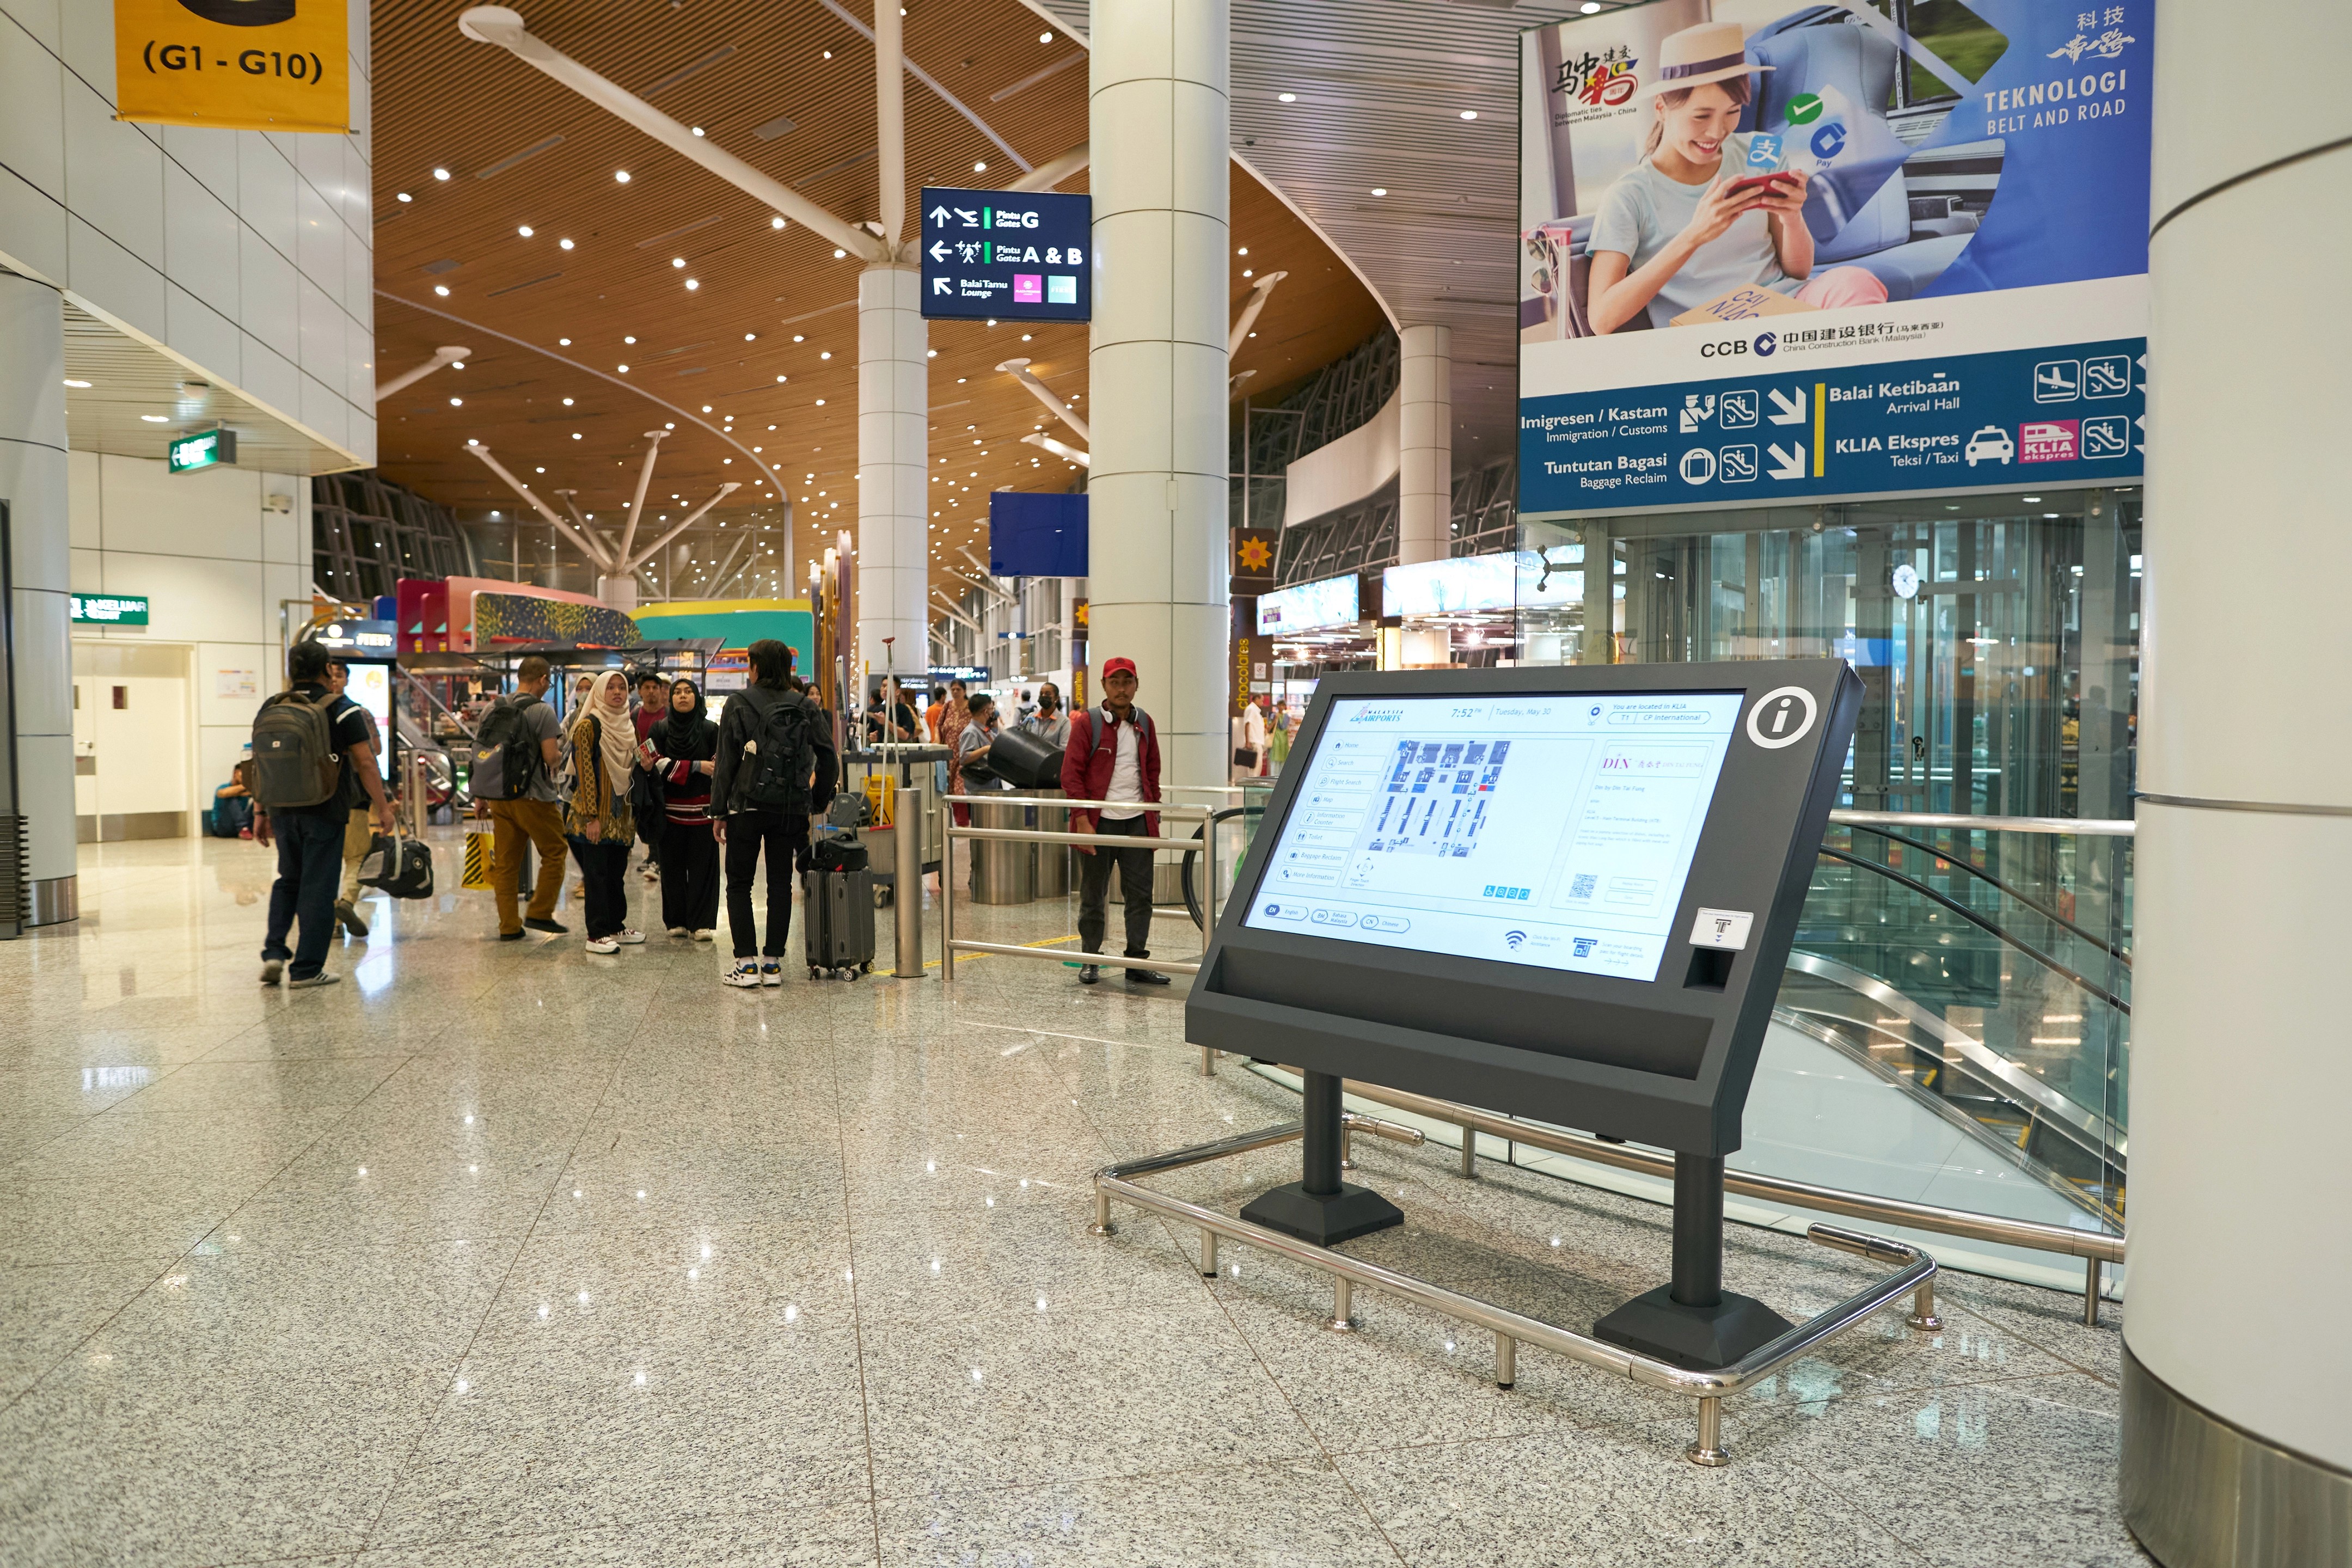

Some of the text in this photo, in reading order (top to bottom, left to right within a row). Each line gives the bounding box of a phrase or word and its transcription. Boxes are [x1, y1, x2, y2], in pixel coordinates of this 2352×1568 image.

[2078, 5, 2125, 30] 科技
[143, 40, 201, 74] (G1
[238, 48, 323, 85] G10)
[1985, 69, 2126, 113] TEKNOLOGI
[1555, 109, 1588, 120] Diplomatic
[1555, 118, 1582, 127] between
[1584, 113, 1612, 121] Malaysia
[1988, 100, 2126, 136] BELT AND ROAD
[1816, 158, 1832, 168] Pay
[996, 210, 1039, 228] Pintu G
[996, 219, 1021, 228] Gates
[996, 246, 1082, 265] Pintu A & B
[996, 254, 1021, 262] Gates
[960, 279, 1007, 289] Balai Tamu
[961, 289, 992, 298] Lounge
[1701, 340, 1748, 358] CCB
[1783, 331, 1926, 353] China Construction Bank (Malaysia)
[1830, 379, 1960, 402] Balai Ketibaan
[1886, 397, 1960, 414] Arrival Hall
[1521, 412, 1594, 430] Imigresen
[1608, 406, 1668, 422] Kastam
[1546, 427, 1608, 443] Immigration
[1619, 423, 1668, 437] Customs
[1836, 433, 1959, 454] KLIA Ekspres
[2025, 442, 2072, 454] KLIA
[1545, 453, 1667, 474] Tuntutan Bagasi
[1890, 455, 1921, 467] Teksi
[1933, 451, 1958, 464] Taxi
[2024, 451, 2074, 460] ekspres
[1581, 473, 1667, 489] Baggage Reclaim
[1236, 638, 1249, 709] chocolates
[1451, 709, 1473, 718] 7:52
[1301, 852, 1321, 860] Baggage
[1306, 872, 1334, 880] Information
